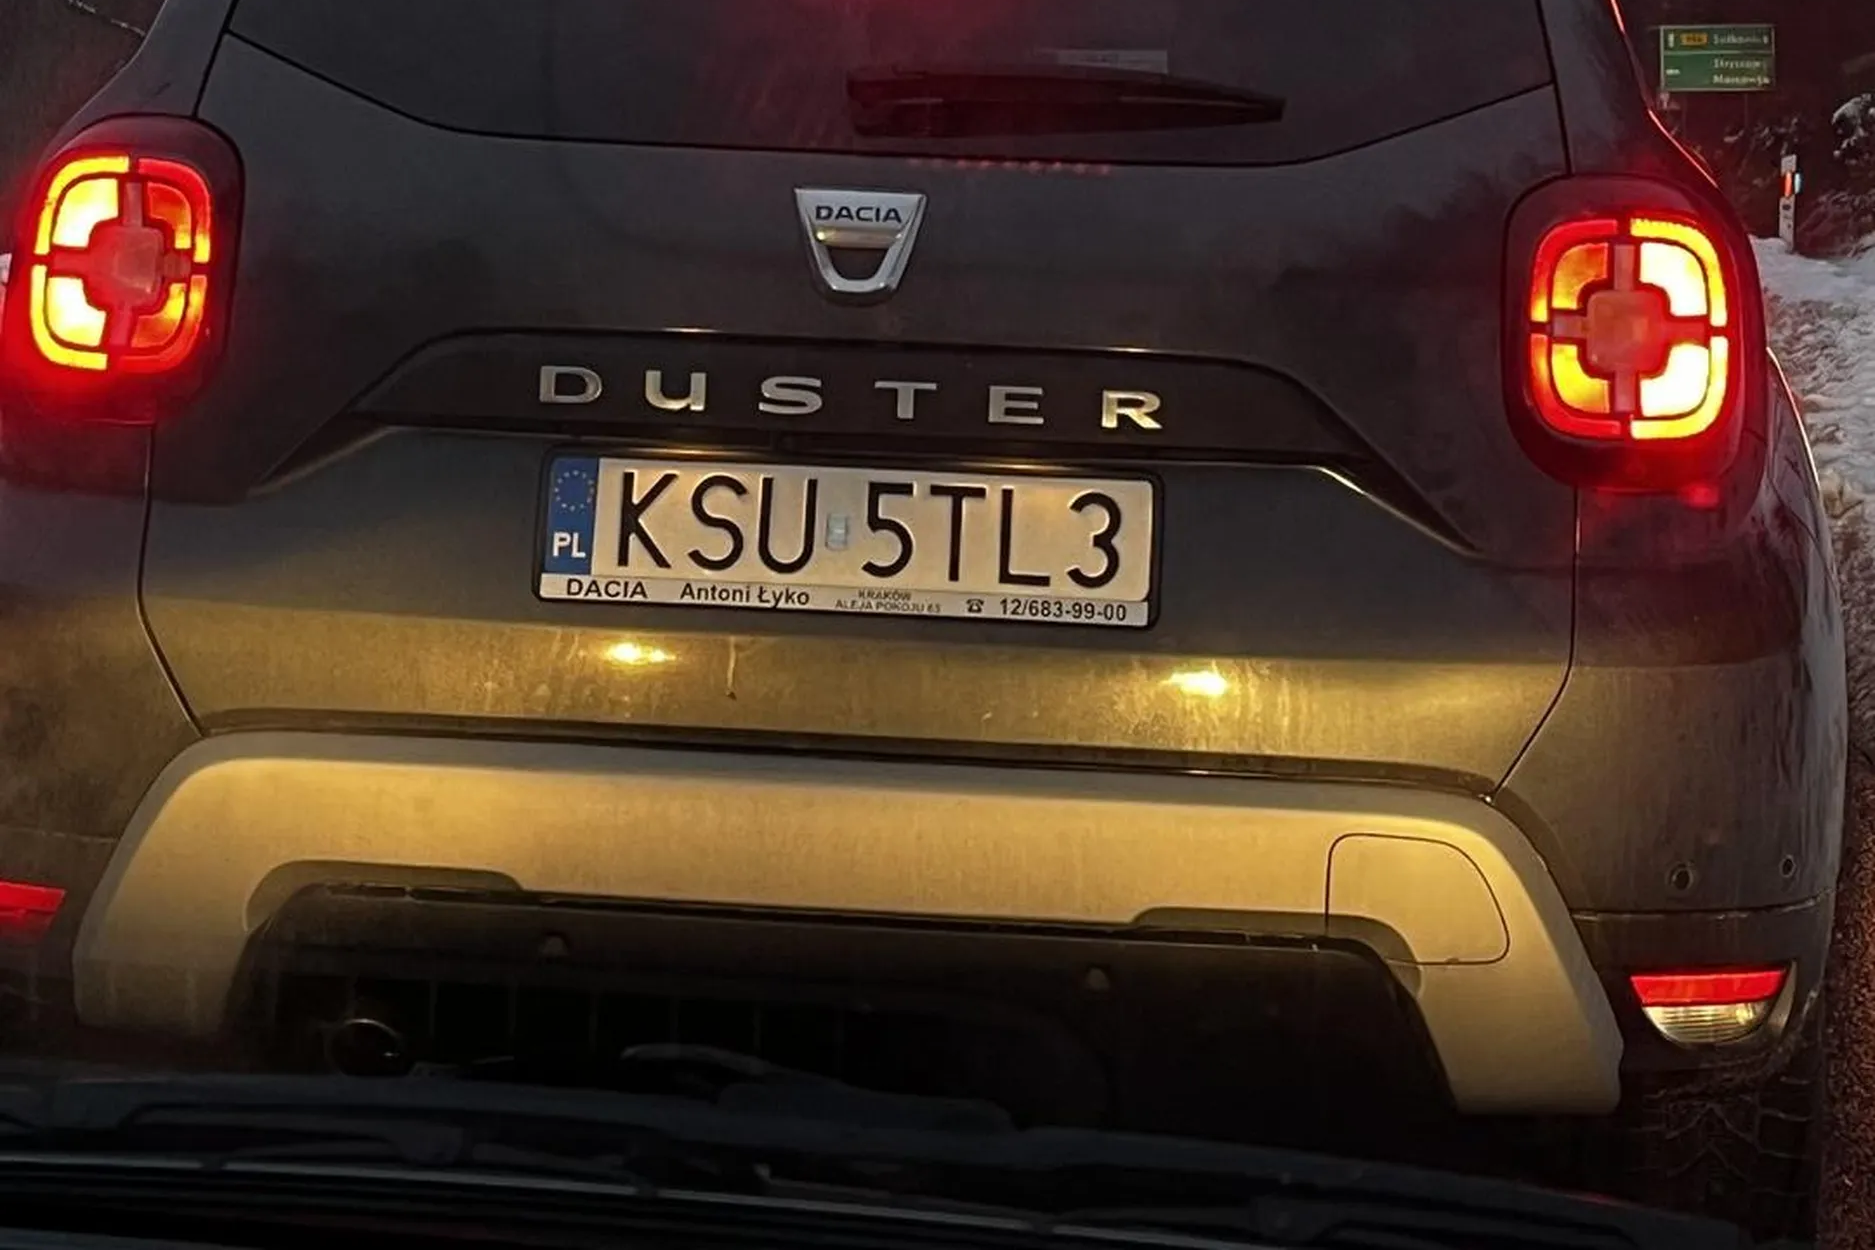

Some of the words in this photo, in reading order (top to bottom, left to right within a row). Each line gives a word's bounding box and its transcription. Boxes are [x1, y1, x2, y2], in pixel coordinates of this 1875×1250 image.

[814, 204, 903, 224] DACIA
[538, 365, 1163, 430] DUSTER
[617, 470, 818, 574] KSU
[861, 481, 1122, 589] 5TL3
[552, 531, 586, 558] PL
[566, 578, 648, 600] DACIA
[680, 582, 750, 603] Antoni
[757, 586, 811, 609] Łyko
[835, 598, 873, 610] ALEJA
[857, 588, 912, 601] KRAKÓW
[1000, 597, 1127, 622] 12/683-99-00
